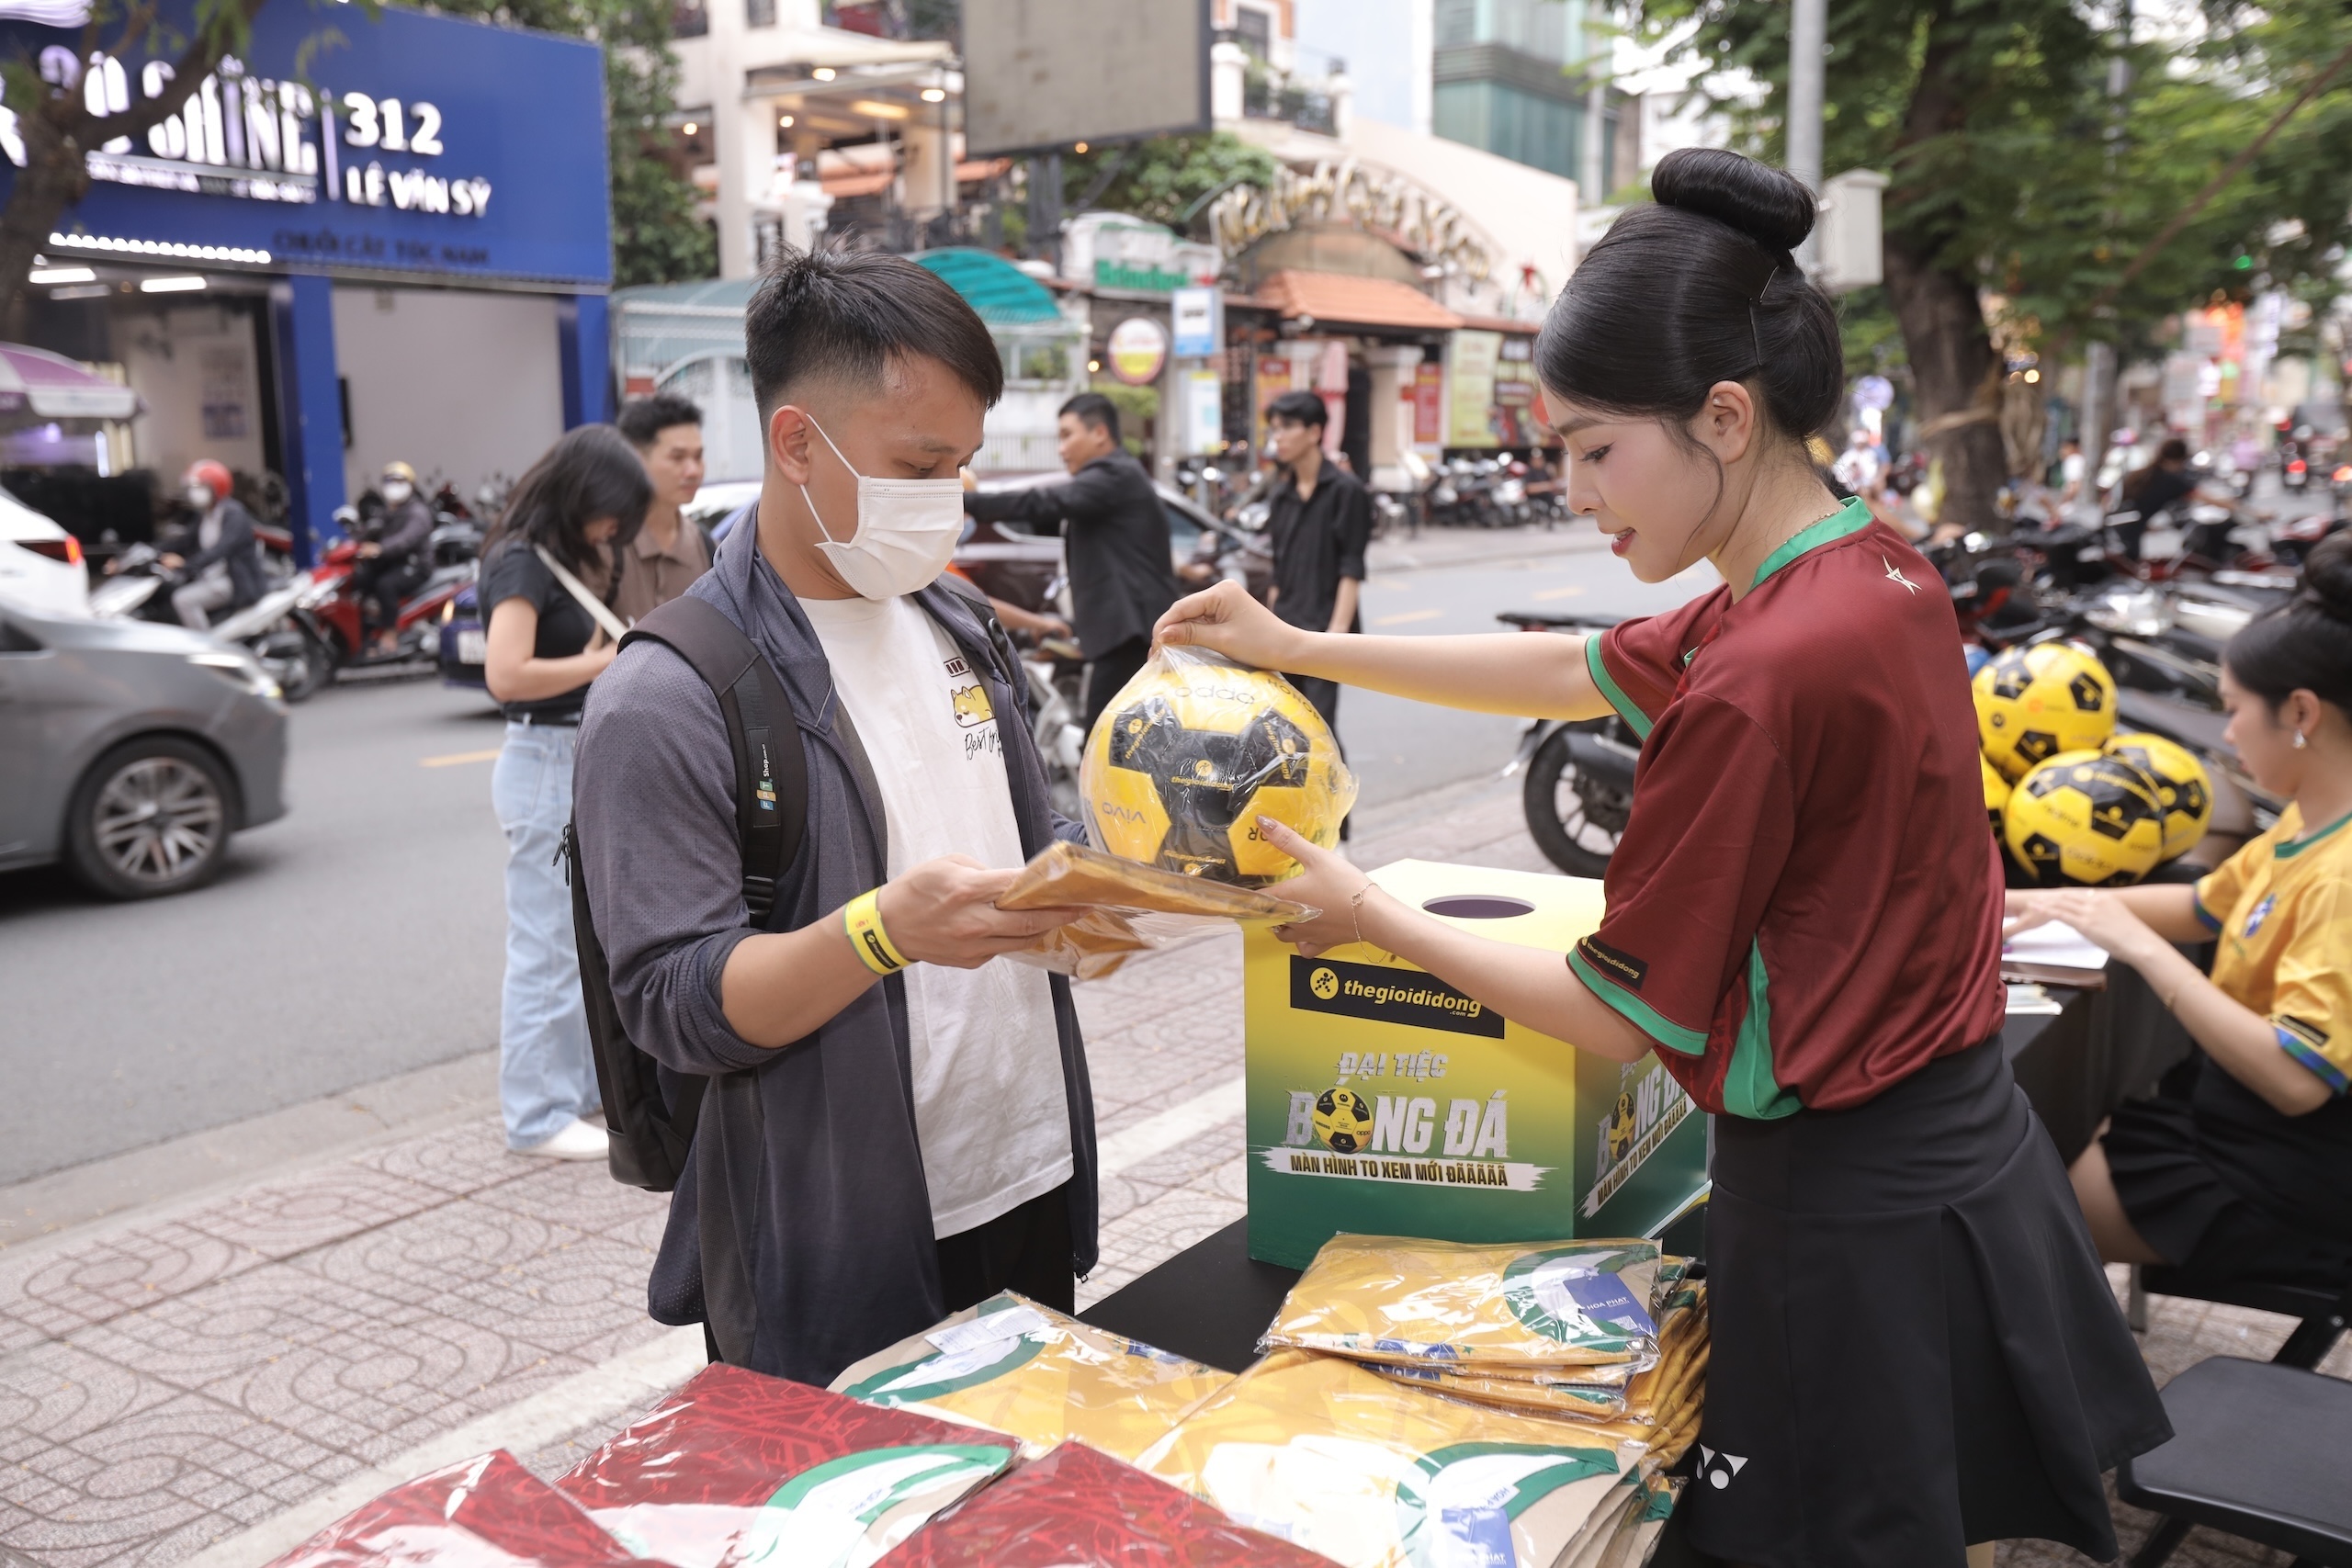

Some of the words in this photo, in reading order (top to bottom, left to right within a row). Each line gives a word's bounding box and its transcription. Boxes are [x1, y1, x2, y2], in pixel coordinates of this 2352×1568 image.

[344, 92, 444, 156] 312
[1102, 802, 1147, 825] vivo
[1587, 942, 1640, 979] thegioididong
[1343, 979, 1482, 1018] thegioididong
[1334, 1052, 1387, 1081] ĐẠI
[1394, 1049, 1448, 1082] TIỆC
[1442, 1089, 1510, 1158] ĐÁ
[1290, 1152, 1320, 1173] MÀN
[1323, 1155, 1357, 1176] HÌNH
[1360, 1159, 1378, 1178] TO
[1381, 1161, 1412, 1180] XEM
[1415, 1160, 1442, 1182] MỚI
[1598, 1180, 1612, 1206] MÀN
[1612, 1166, 1629, 1191] HÌNH
[1628, 1153, 1637, 1171] TO
[1638, 1137, 1651, 1163] XEM
[1587, 1302, 1605, 1311] HOA
[1606, 1296, 1627, 1306] PHAT
